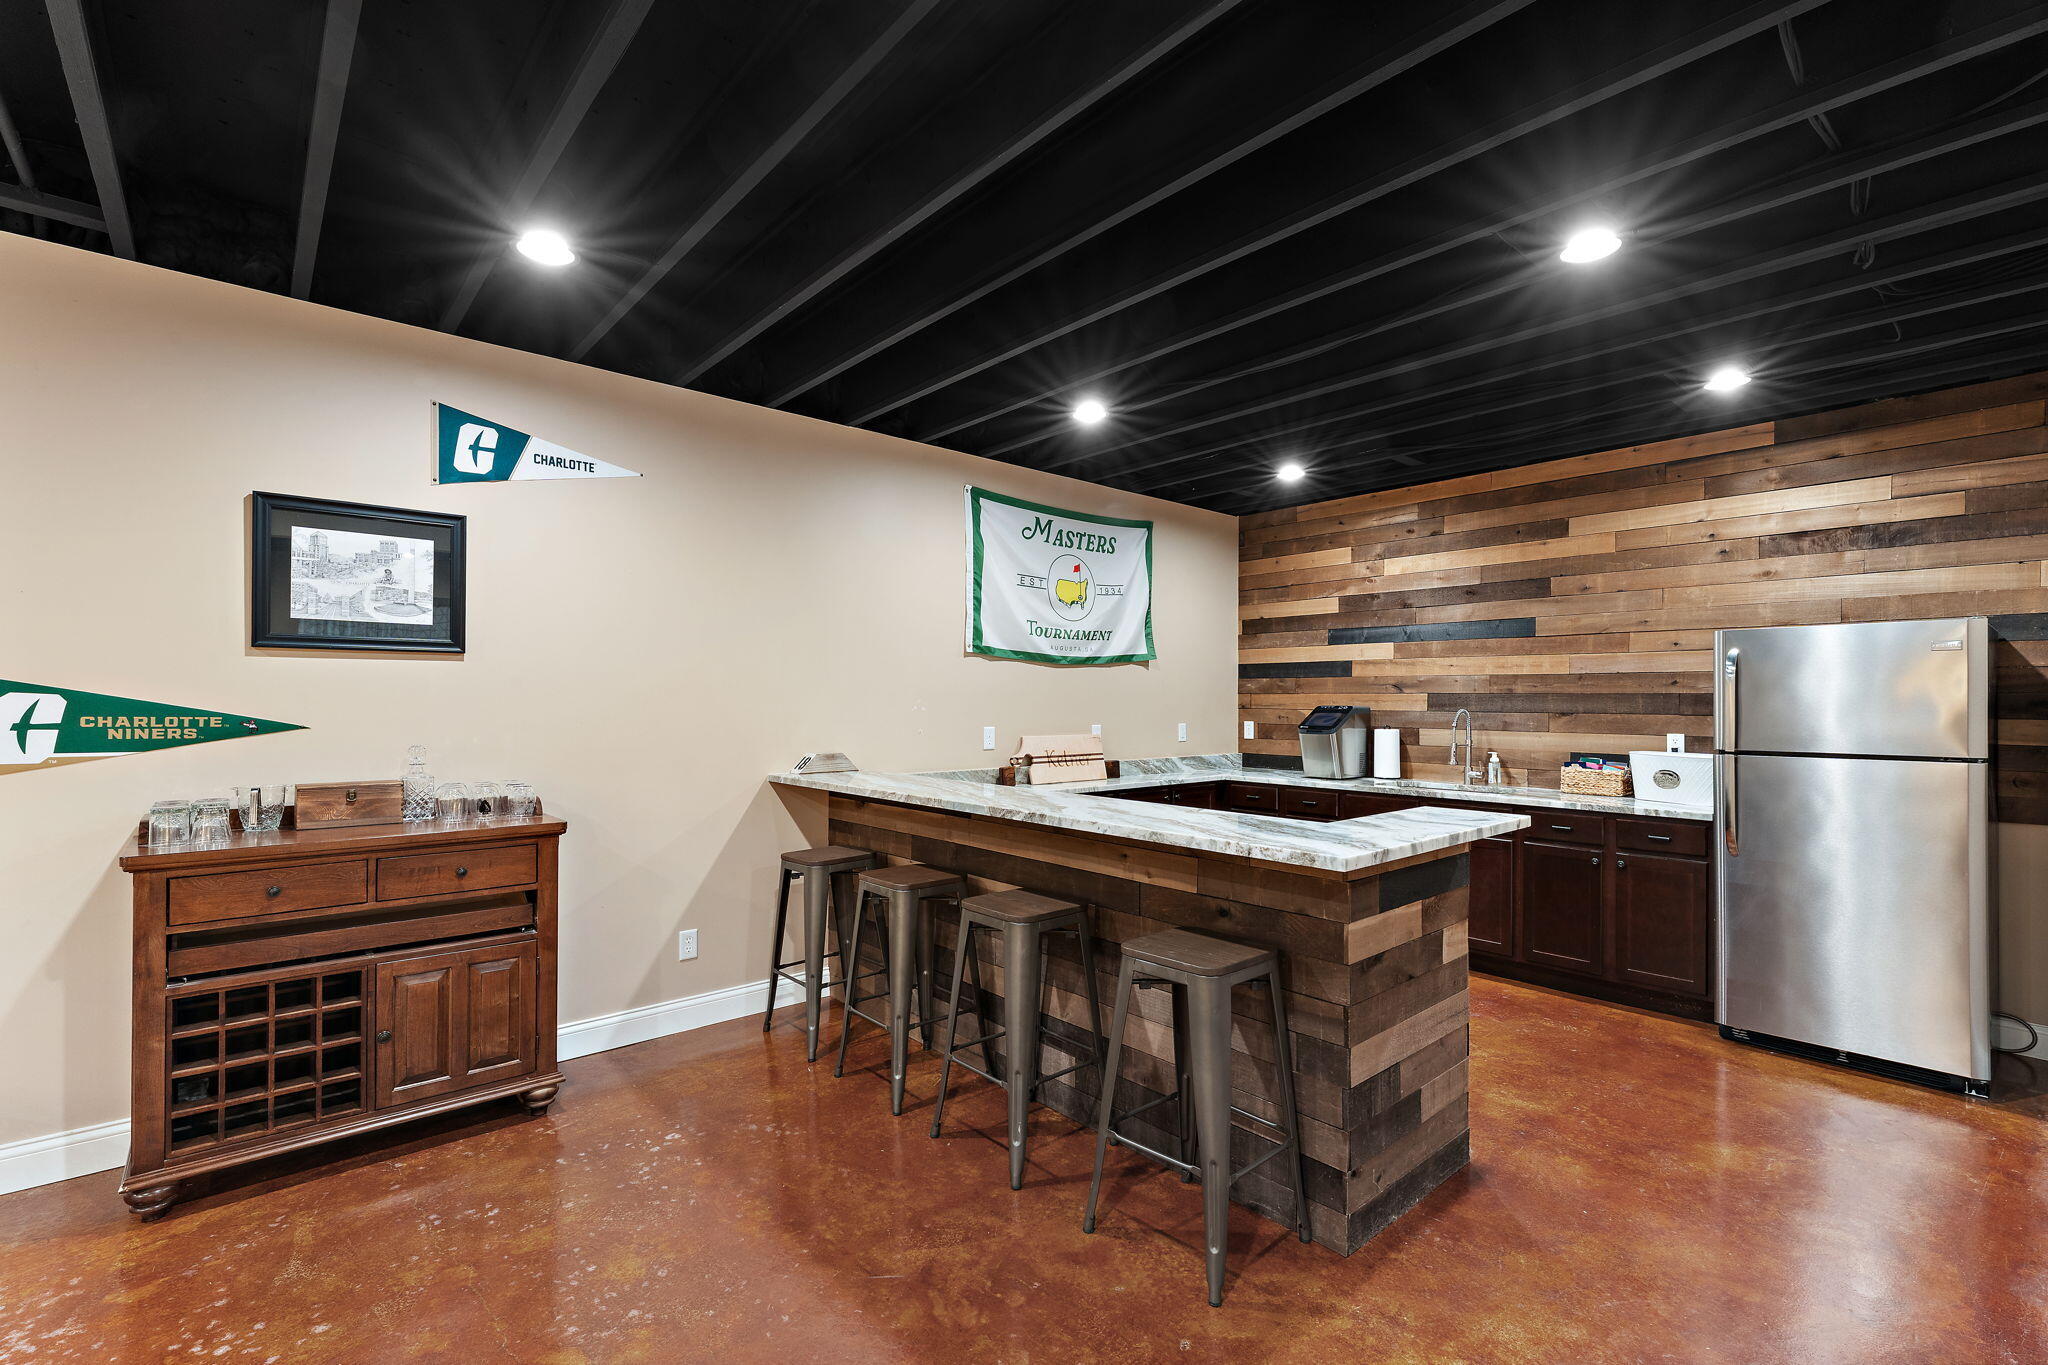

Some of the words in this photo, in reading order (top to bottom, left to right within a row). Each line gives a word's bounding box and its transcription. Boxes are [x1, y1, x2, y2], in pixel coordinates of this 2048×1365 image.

[533, 453, 595, 473] CHARLOTTE
[1020, 575, 1045, 587] EST
[1099, 587, 1122, 596] 1934
[1026, 619, 1113, 642] TOURNAMENT
[79, 716, 223, 728] CHARLOTTE
[107, 728, 198, 740] NINERS
